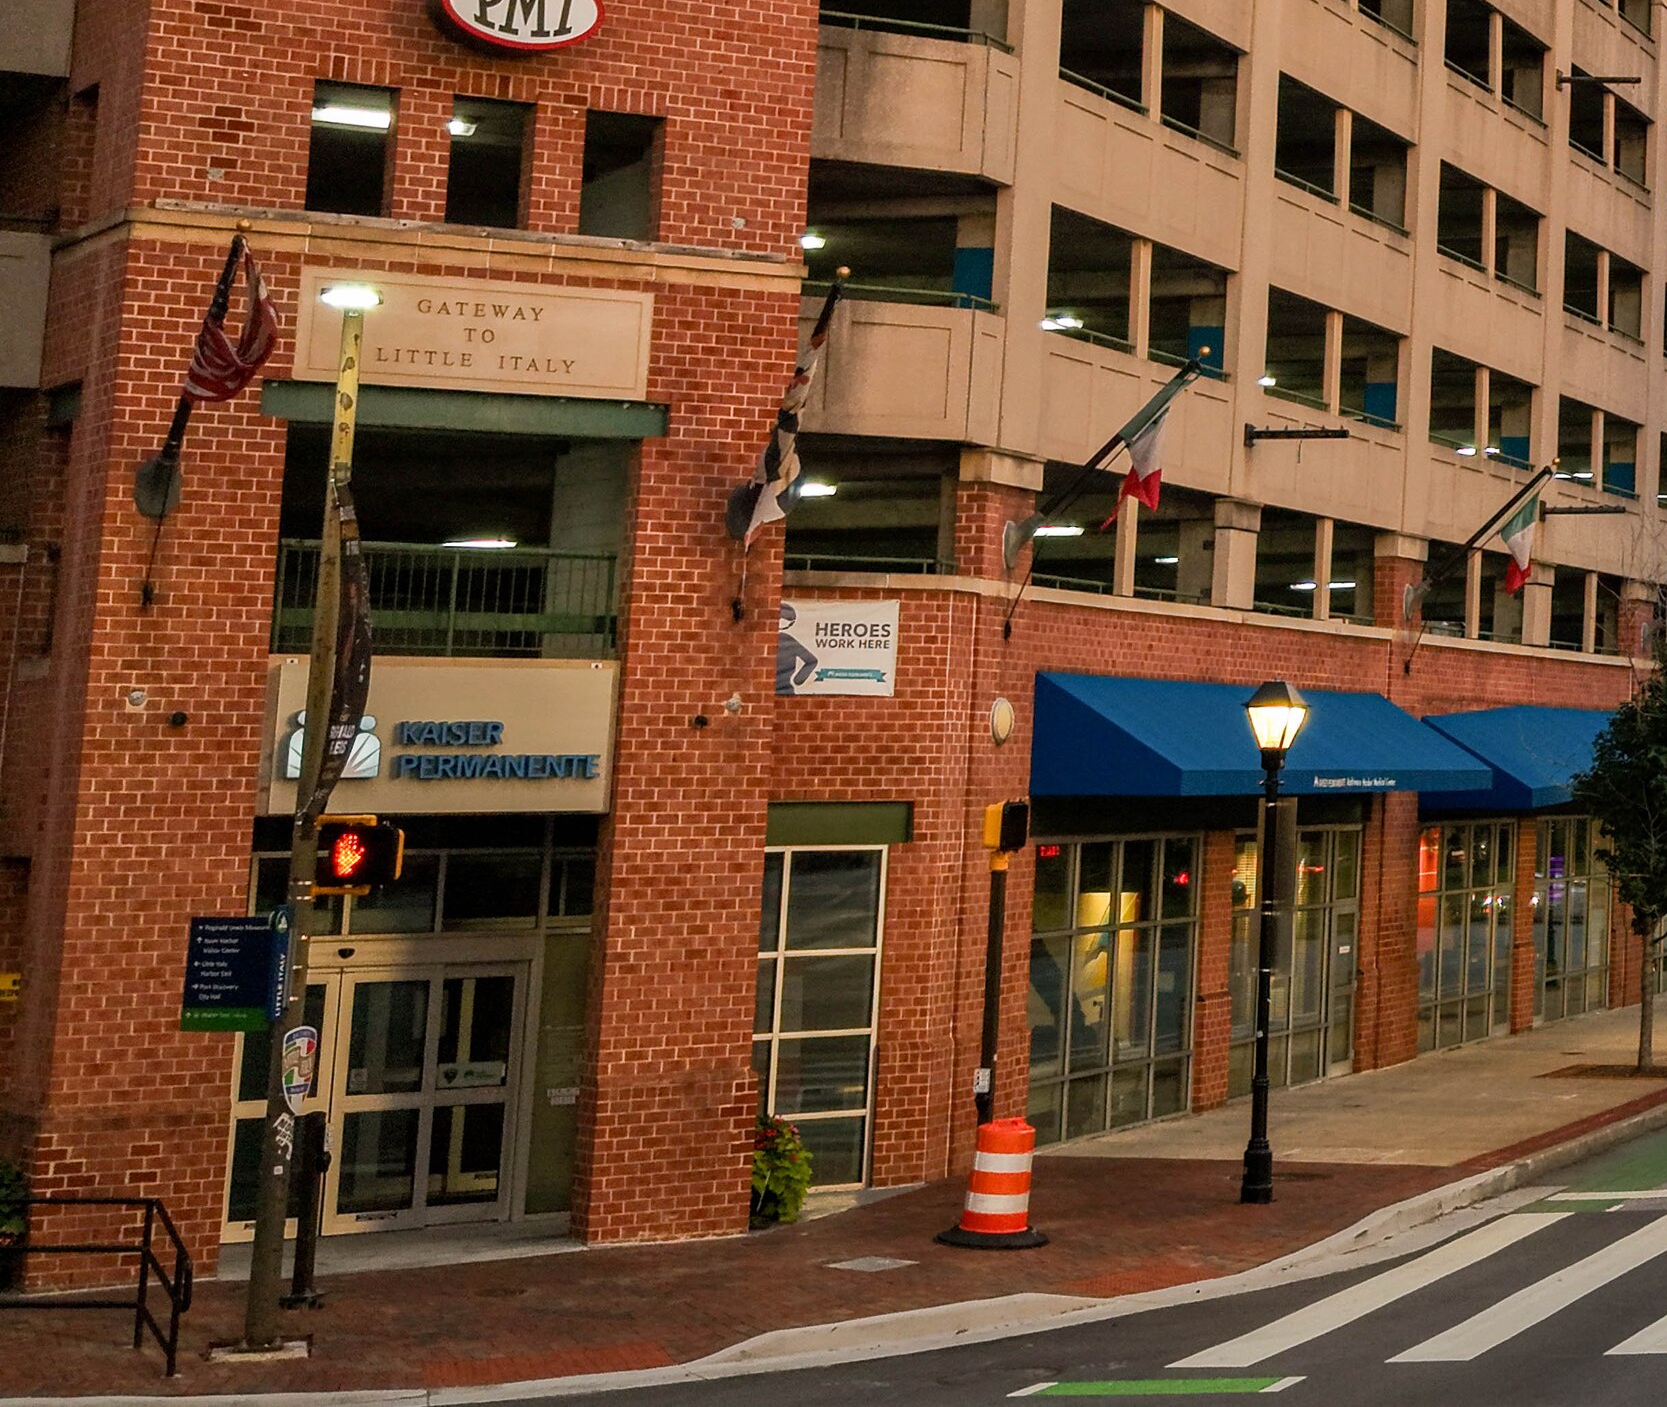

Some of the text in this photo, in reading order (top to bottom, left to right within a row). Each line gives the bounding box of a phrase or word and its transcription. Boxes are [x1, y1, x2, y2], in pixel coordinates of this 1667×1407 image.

[416, 298, 545, 322] GATEWAY
[463, 327, 496, 344] TO
[376, 347, 577, 375] LITTLE ITALY
[815, 622, 891, 638] HEROES
[815, 638, 890, 650] WORK HERE
[400, 720, 505, 746] KAISER
[397, 753, 601, 780] PERMANENTE
[274, 952, 287, 1018] LITTLE ITALY
